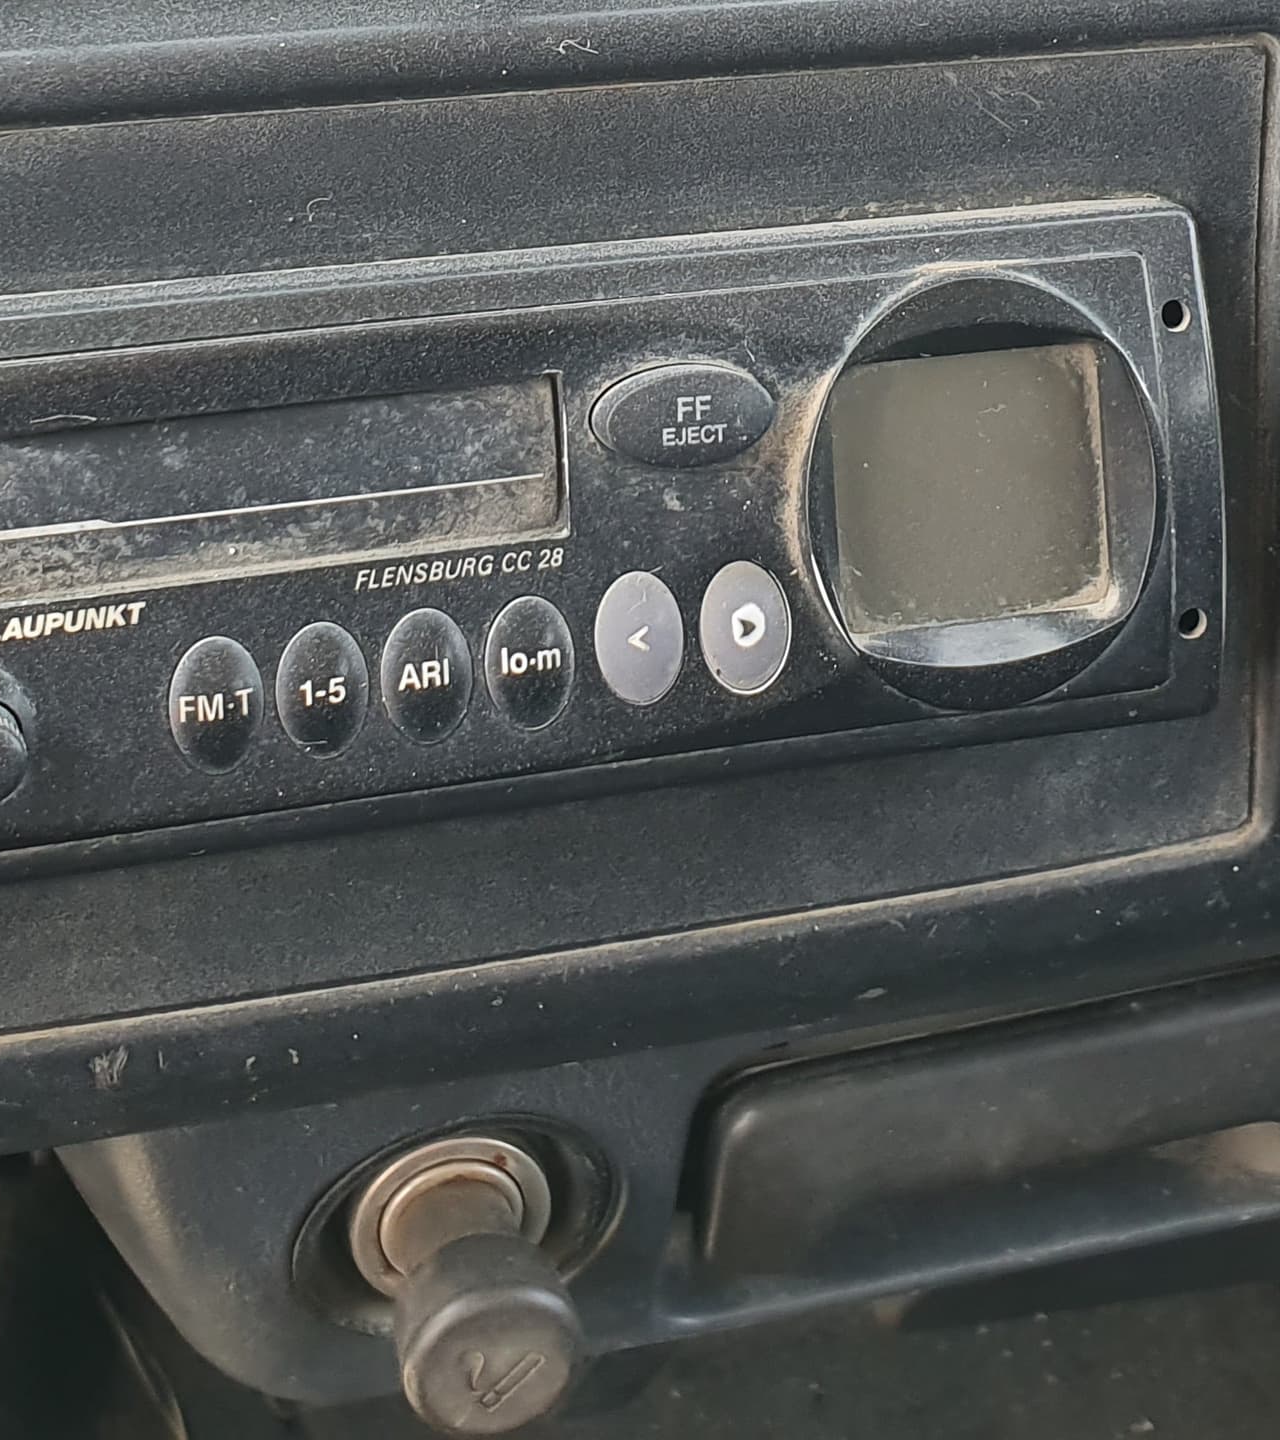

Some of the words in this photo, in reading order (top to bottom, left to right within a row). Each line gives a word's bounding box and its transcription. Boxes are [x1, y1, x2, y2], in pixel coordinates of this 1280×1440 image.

[676, 395, 712, 422] FF
[661, 423, 728, 447] EJECT
[354, 556, 494, 590] FLENSBURG
[500, 551, 532, 574] CC
[537, 547, 564, 569] 28
[398, 658, 451, 691] ARI
[299, 677, 346, 707] 1-5
